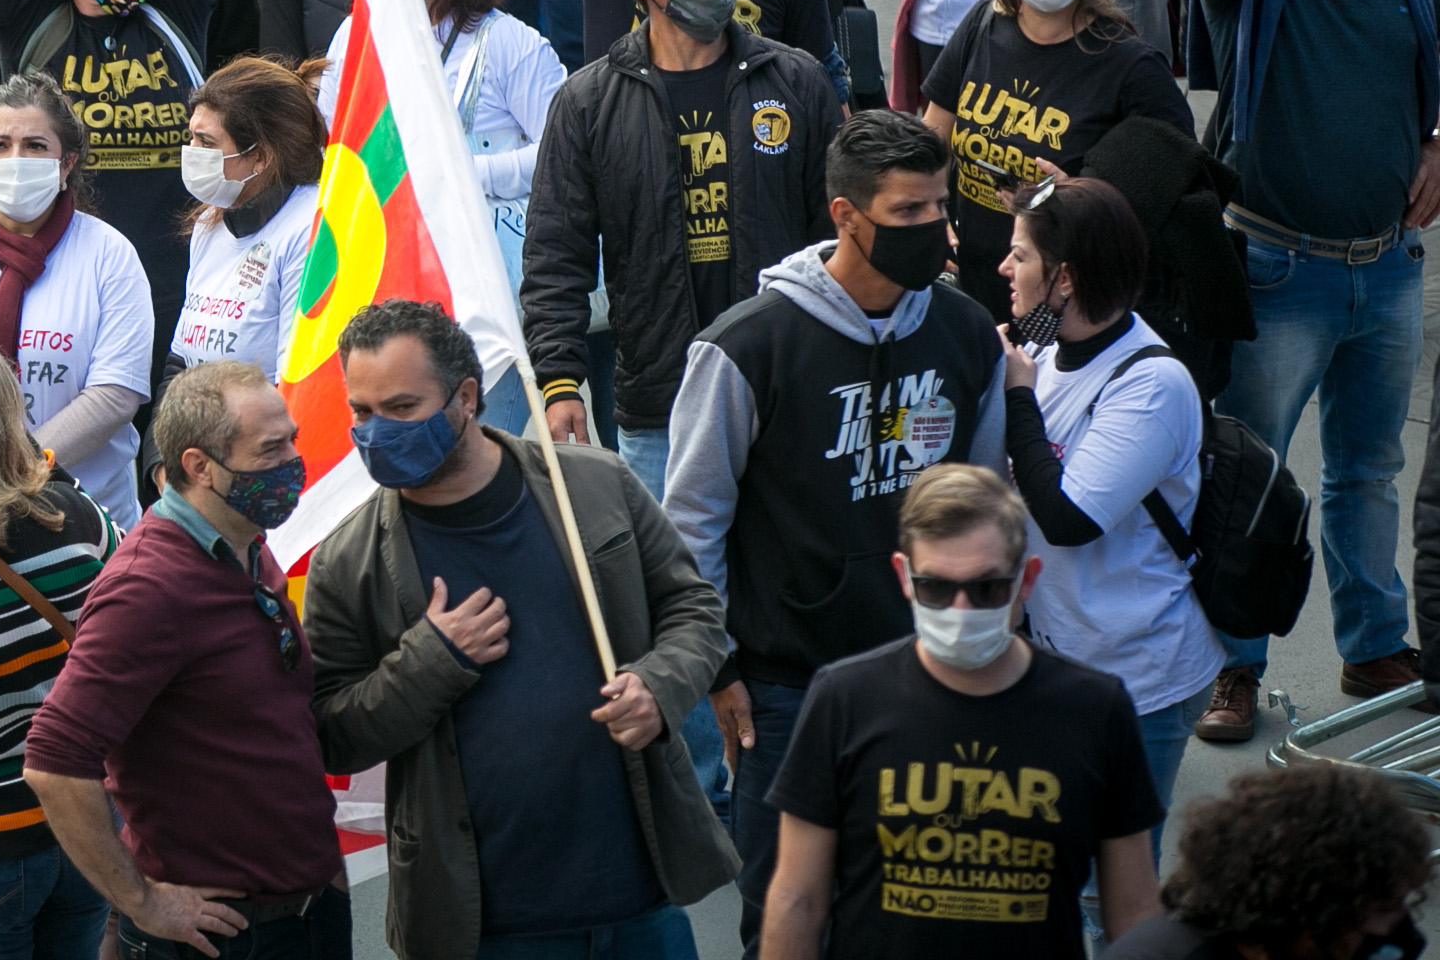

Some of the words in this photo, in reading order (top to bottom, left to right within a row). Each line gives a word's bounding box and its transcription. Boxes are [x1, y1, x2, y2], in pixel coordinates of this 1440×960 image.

[62, 50, 178, 98] LUTAR
[98, 91, 119, 102] OU
[753, 99, 787, 111] ESCOLA
[956, 81, 1070, 151] LUTAR
[89, 129, 191, 146] BALHANDO
[980, 125, 1000, 140] OU
[200, 296, 246, 320] DIREITOS
[17, 329, 74, 352] EITOS
[206, 329, 238, 355] FAZ
[27, 361, 69, 386] FAZ
[852, 484, 866, 502] IN
[869, 477, 897, 496] THE
[878, 762, 1061, 823] LUTAR
[933, 813, 962, 829] OU
[875, 822, 1055, 869] MORRER
[882, 863, 1051, 890] TRABALHANDO
[887, 889, 936, 913] NÃO
